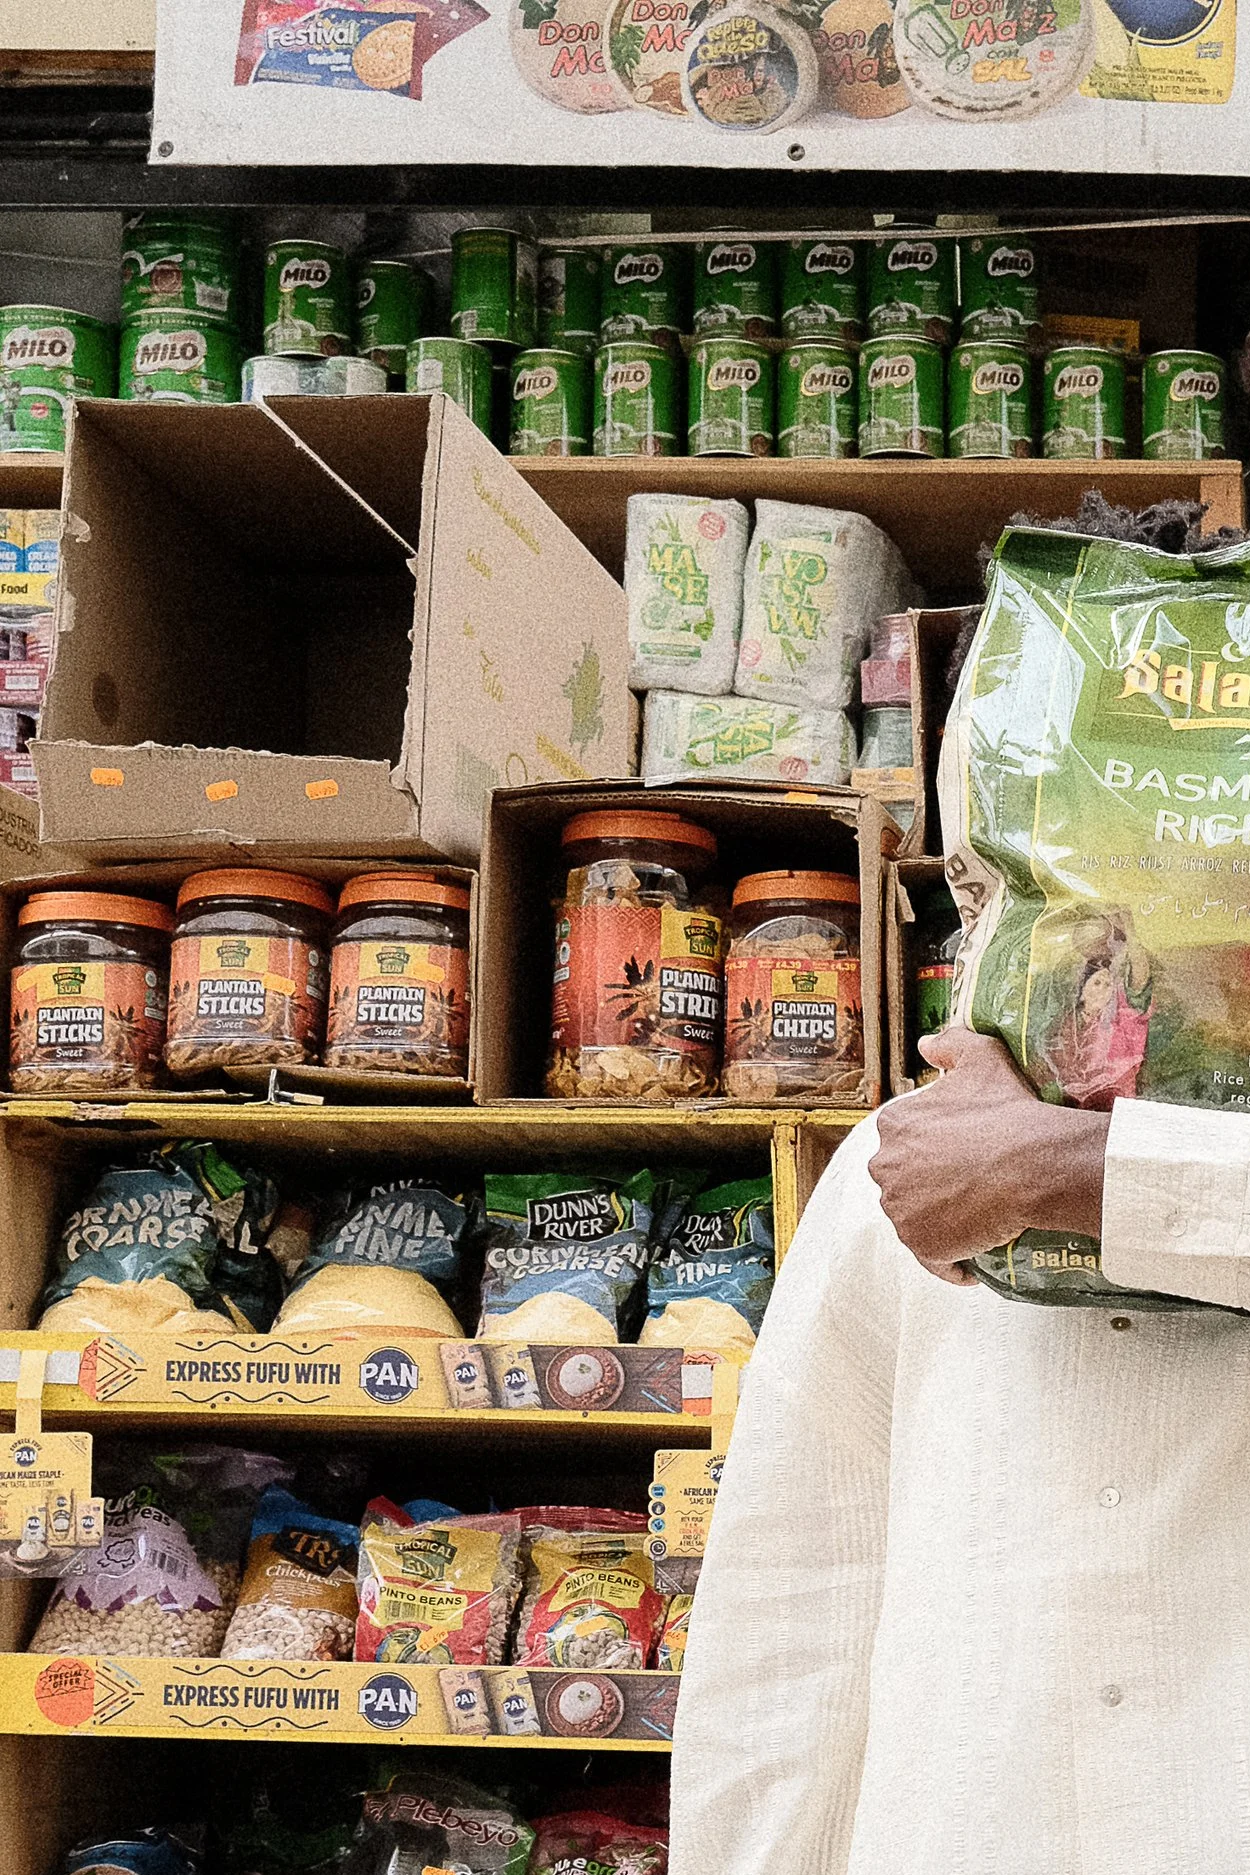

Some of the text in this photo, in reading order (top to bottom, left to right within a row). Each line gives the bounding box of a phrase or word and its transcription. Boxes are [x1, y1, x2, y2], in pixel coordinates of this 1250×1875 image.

[632, 0, 688, 22] Don
[266, 19, 355, 49] Festival
[538, 21, 600, 46] Don
[709, 252, 750, 268] MILO
[809, 252, 850, 269] MILO
[283, 266, 328, 285] MILO
[618, 263, 660, 278] MILO
[7, 339, 67, 360] MILO
[140, 341, 199, 364] MILO
[1, 583, 28, 595] Food
[1081, 855, 1100, 868] RIS
[1110, 855, 1131, 868] RIZ
[1181, 857, 1222, 872] ARROZ
[691, 942, 715, 955] SUN
[358, 985, 424, 1003] PLANTAIN
[38, 1006, 103, 1023] PLANTAIN
[198, 997, 265, 1016] STICKS
[773, 1002, 835, 1018] PLANTAIN
[215, 1019, 244, 1030] Sweet
[373, 1027, 402, 1038] Sweet
[773, 1018, 836, 1039] CHIPS
[37, 1024, 103, 1045] STICKS
[55, 1048, 84, 1058] Sweet
[1213, 1071, 1244, 1085] Rice
[534, 1194, 611, 1226] DUNN'S
[544, 1218, 603, 1240] RIVER
[66, 1216, 212, 1262] COARSE
[1032, 1247, 1101, 1272] Salaa
[677, 1260, 732, 1285] FINE
[166, 1360, 341, 1385] EXPRESS FUFU WITH
[684, 1488, 712, 1497] AFRICAN
[396, 1541, 453, 1558] TROPICAL
[266, 1565, 341, 1588] Chickpeas
[565, 1573, 640, 1592] PINTO BEANS
[380, 1586, 462, 1605] PINTO BEANS
[52, 1677, 82, 1688] OFFER
[163, 1685, 339, 1710] EXPRESS FUFU WITH
[390, 1795, 520, 1847] Plebeyo
